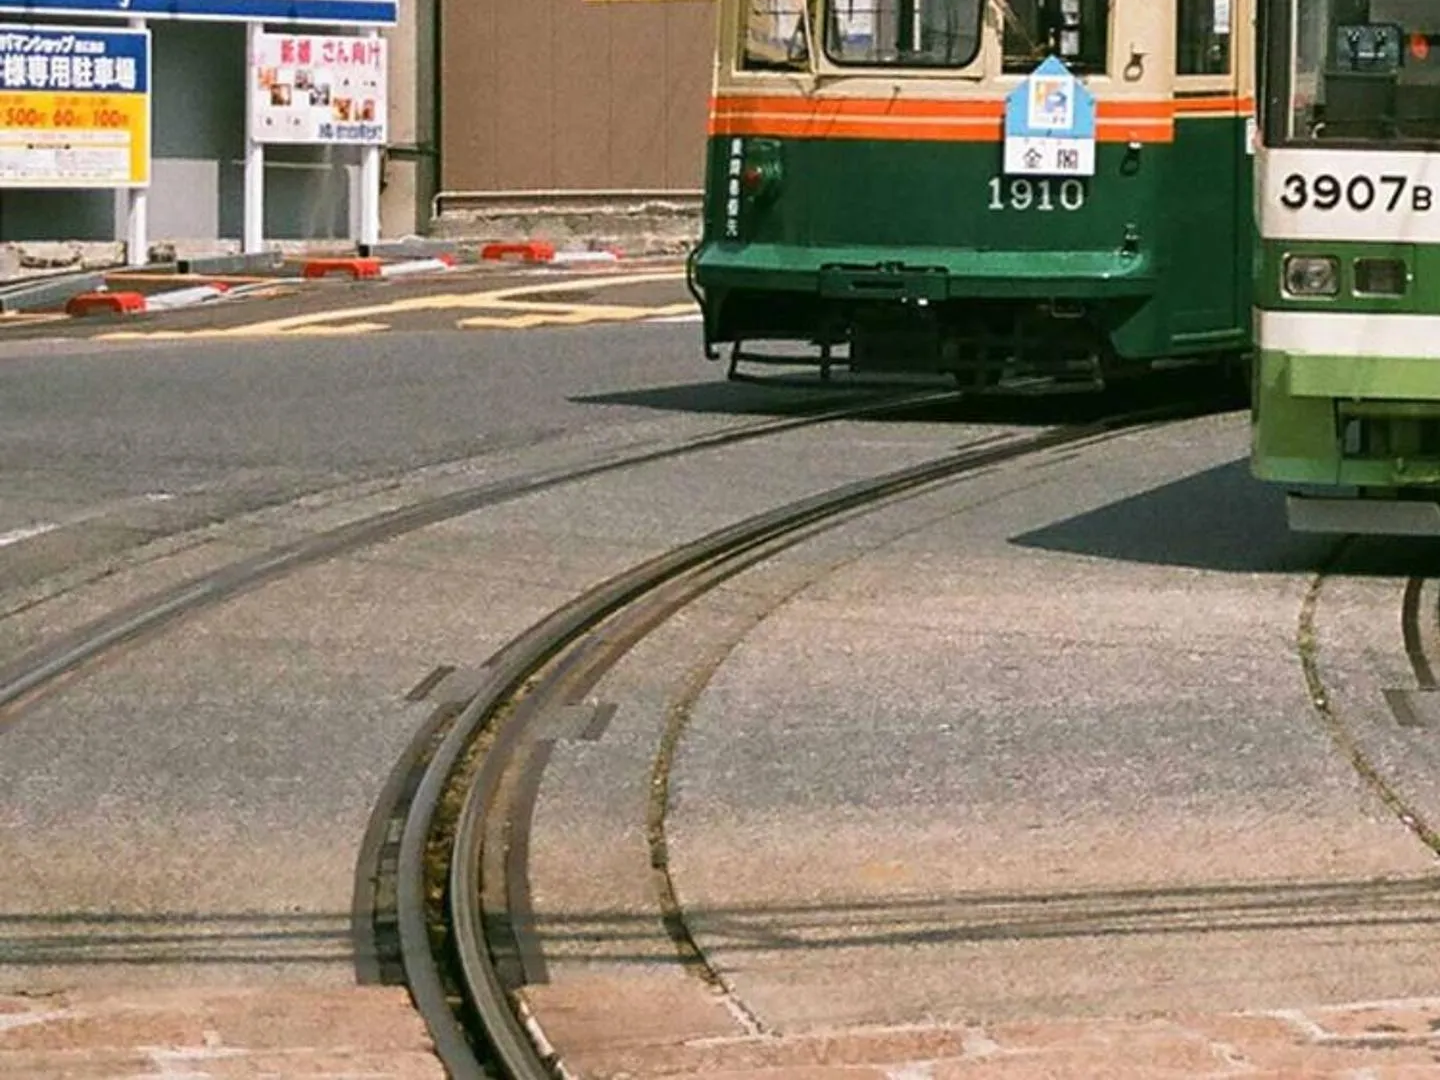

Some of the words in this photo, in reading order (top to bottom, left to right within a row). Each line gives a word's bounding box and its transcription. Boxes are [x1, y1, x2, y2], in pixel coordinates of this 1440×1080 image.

[0, 53, 137, 90] 様専用駐車場
[988, 177, 1084, 211] 1910
[1280, 173, 1432, 212] 3907B
